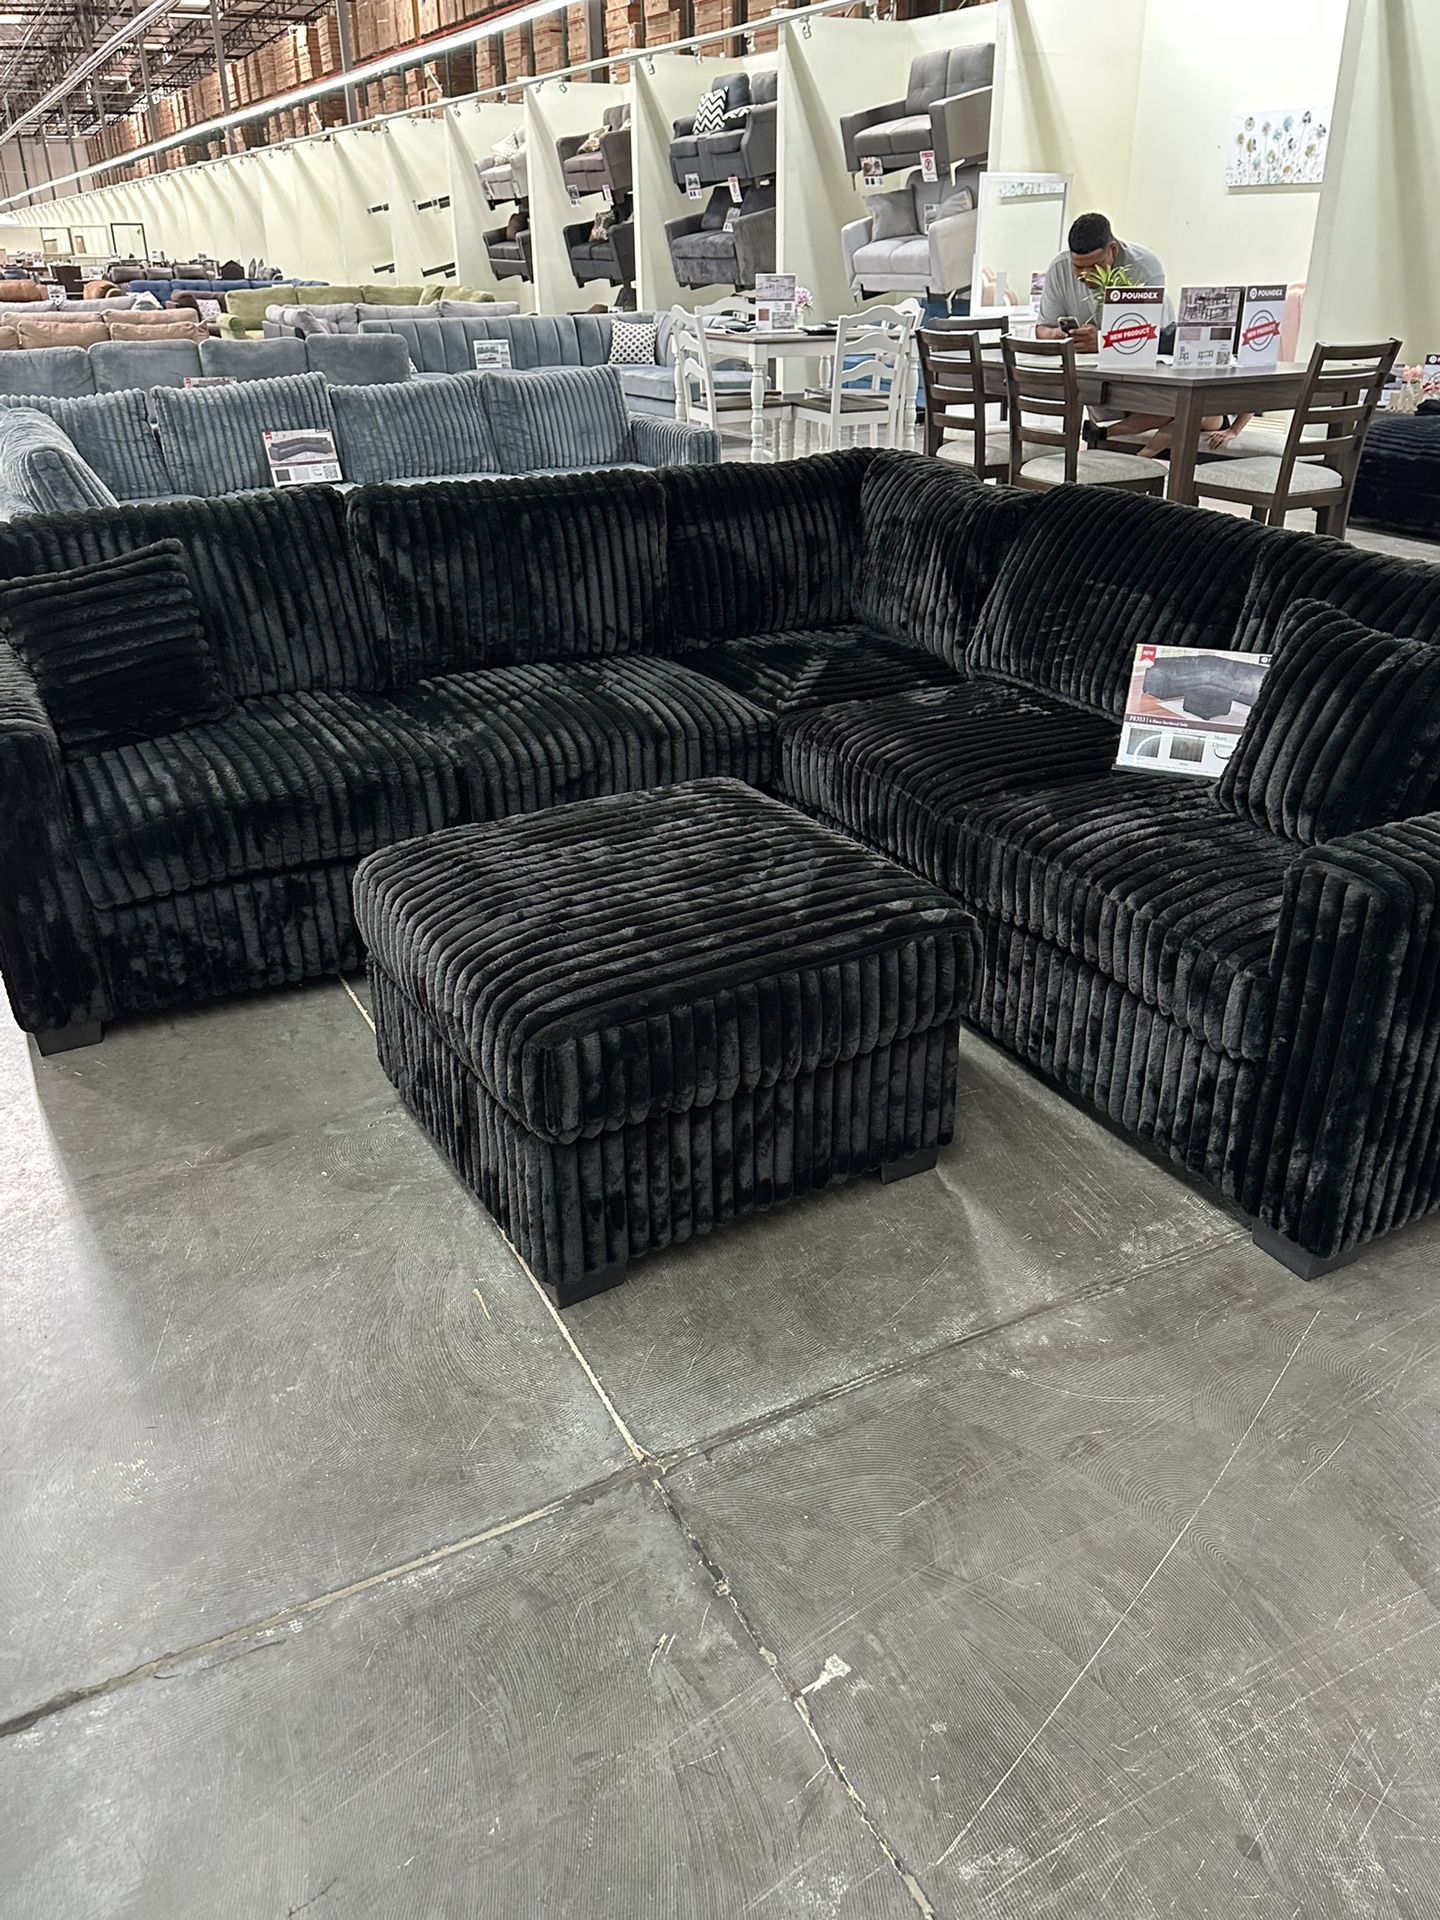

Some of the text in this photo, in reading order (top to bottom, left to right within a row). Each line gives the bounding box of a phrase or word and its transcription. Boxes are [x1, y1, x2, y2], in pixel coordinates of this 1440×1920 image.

[1121, 292, 1158, 300] POUNDEX
[1257, 288, 1283, 296] POUNDEX
[1110, 326, 1150, 341] NEW PRODUCT
[1256, 322, 1276, 335] PRODUCT
